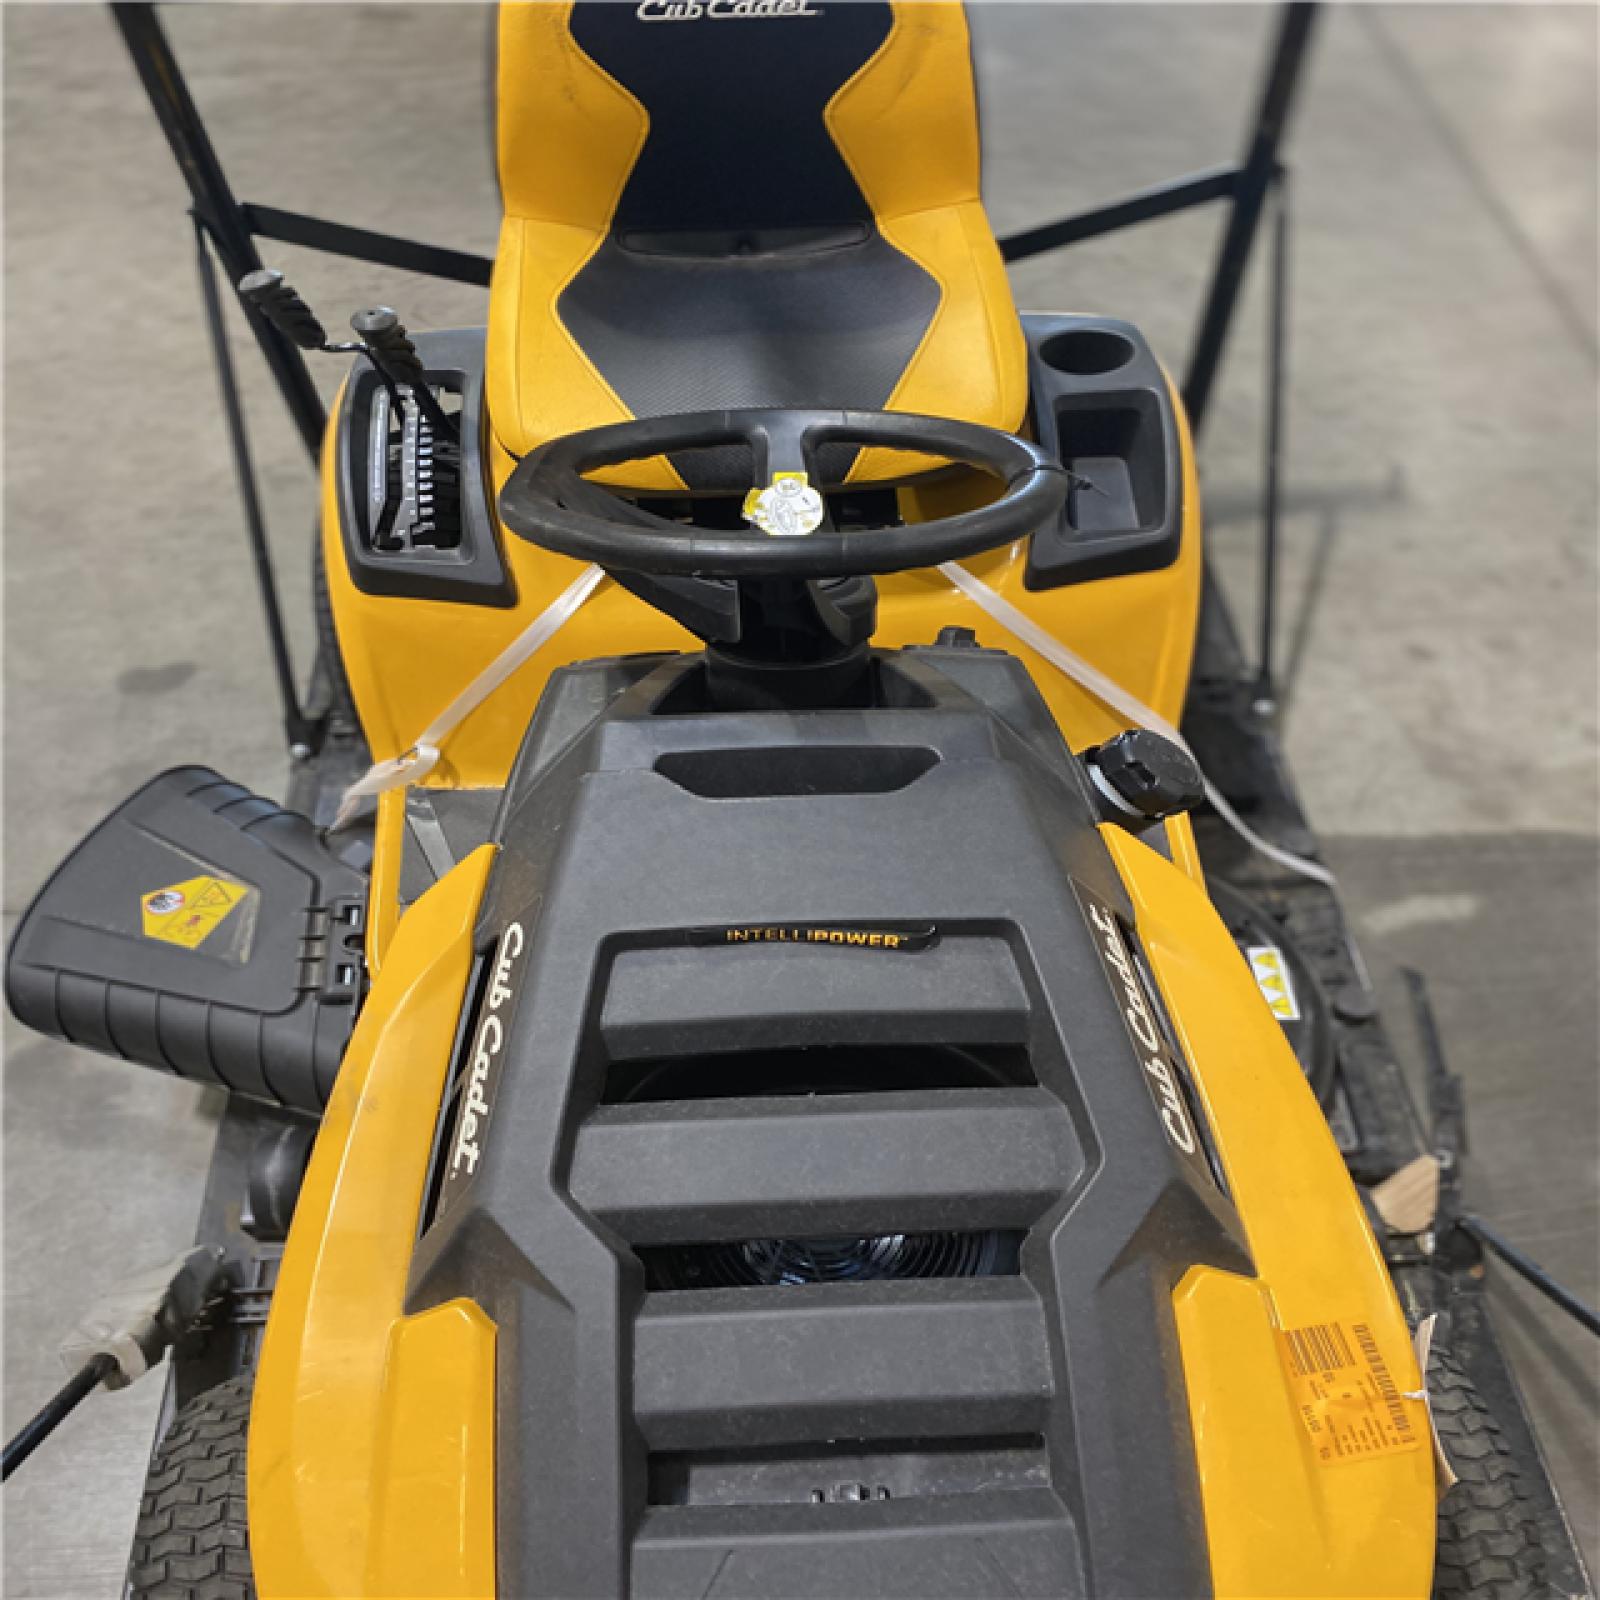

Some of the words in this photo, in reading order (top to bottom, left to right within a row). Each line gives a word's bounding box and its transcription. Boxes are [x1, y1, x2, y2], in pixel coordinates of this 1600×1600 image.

[637, 0, 702, 21] Cub
[488, 921, 525, 1010] Cub
[1088, 903, 1159, 1053] Cadet
[453, 1014, 503, 1176] Cadet
[1145, 1057, 1196, 1155] Cub
